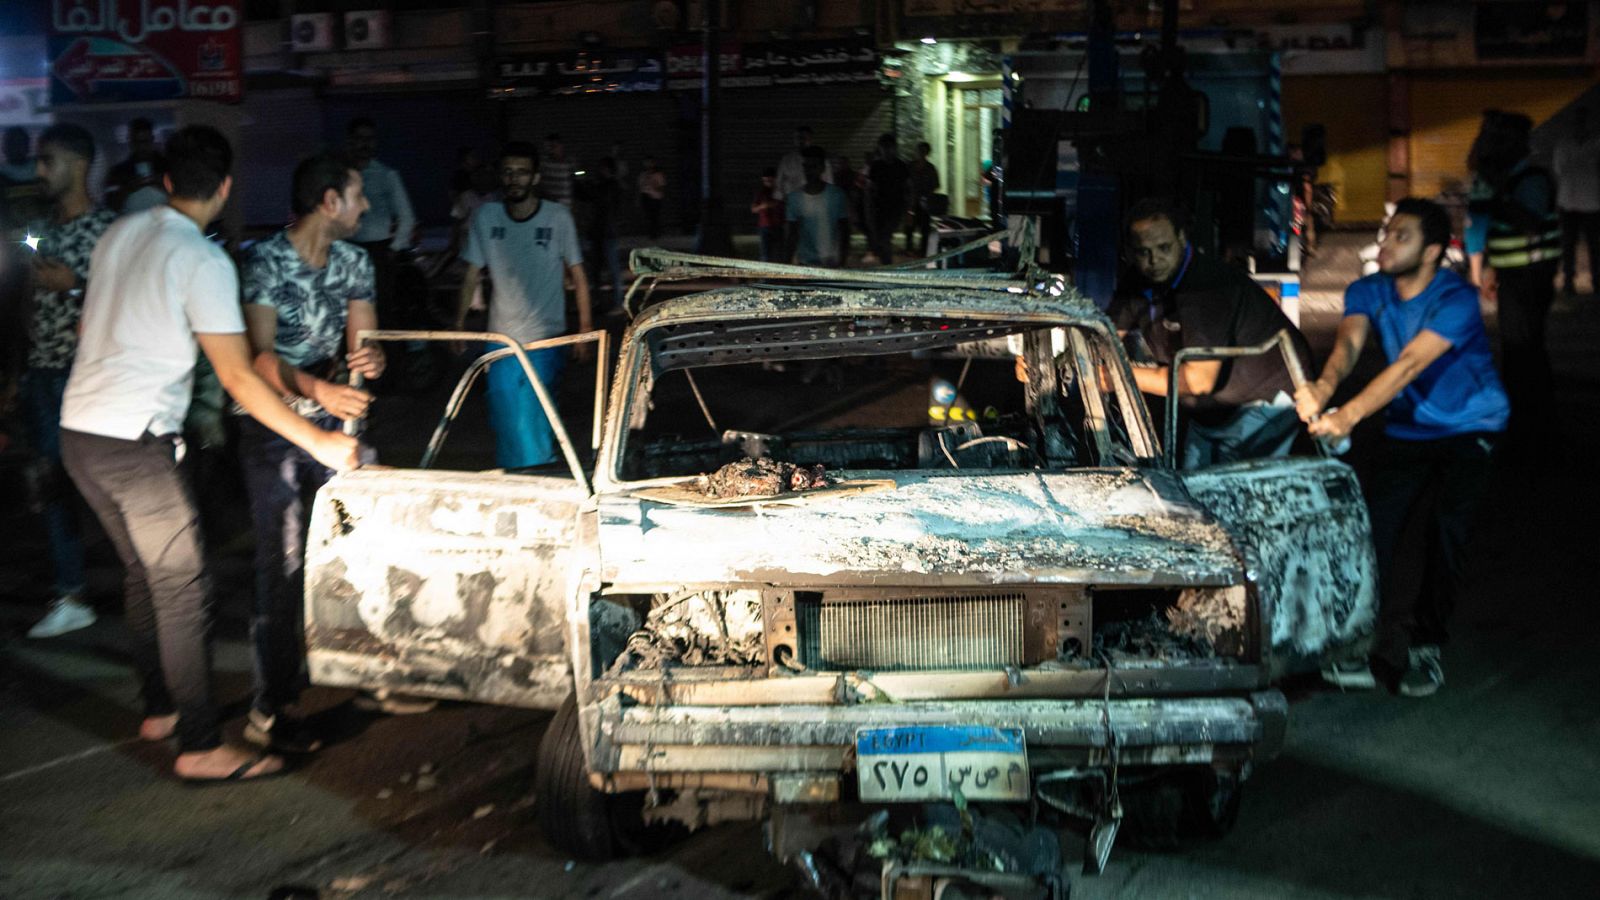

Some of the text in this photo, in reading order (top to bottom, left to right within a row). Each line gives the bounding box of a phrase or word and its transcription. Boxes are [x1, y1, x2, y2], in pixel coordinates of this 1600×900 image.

[118, 0, 239, 43] معامل
[871, 732, 926, 750] EGYPT
[873, 760, 928, 792] ٢٧٥
